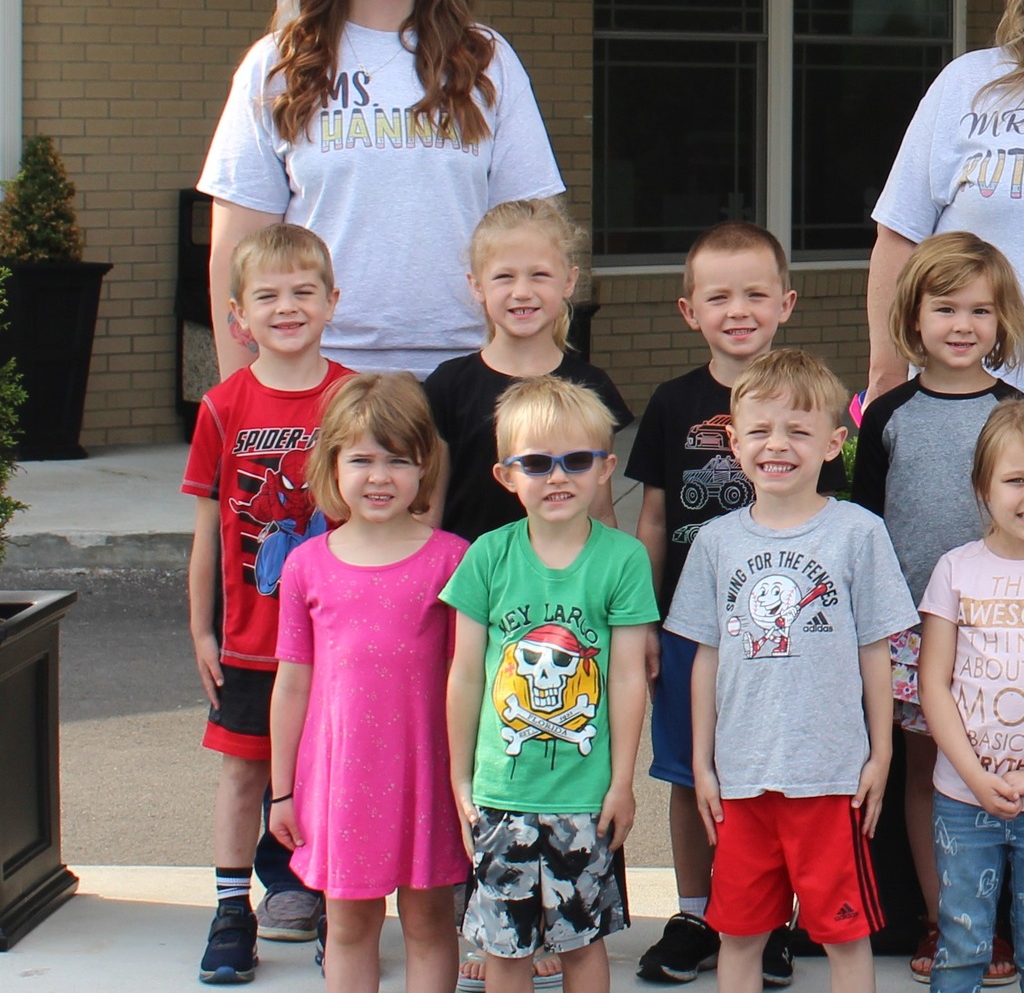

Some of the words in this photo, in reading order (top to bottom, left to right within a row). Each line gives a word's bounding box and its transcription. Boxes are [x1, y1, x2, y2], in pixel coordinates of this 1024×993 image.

[320, 108, 479, 157] HANNA
[725, 568, 748, 612] SWING
[747, 551, 773, 575] FOR
[778, 550, 805, 571] THE
[801, 558, 839, 608] FENCES
[803, 624, 834, 633] adidas
[527, 713, 568, 736] FLORIDA
